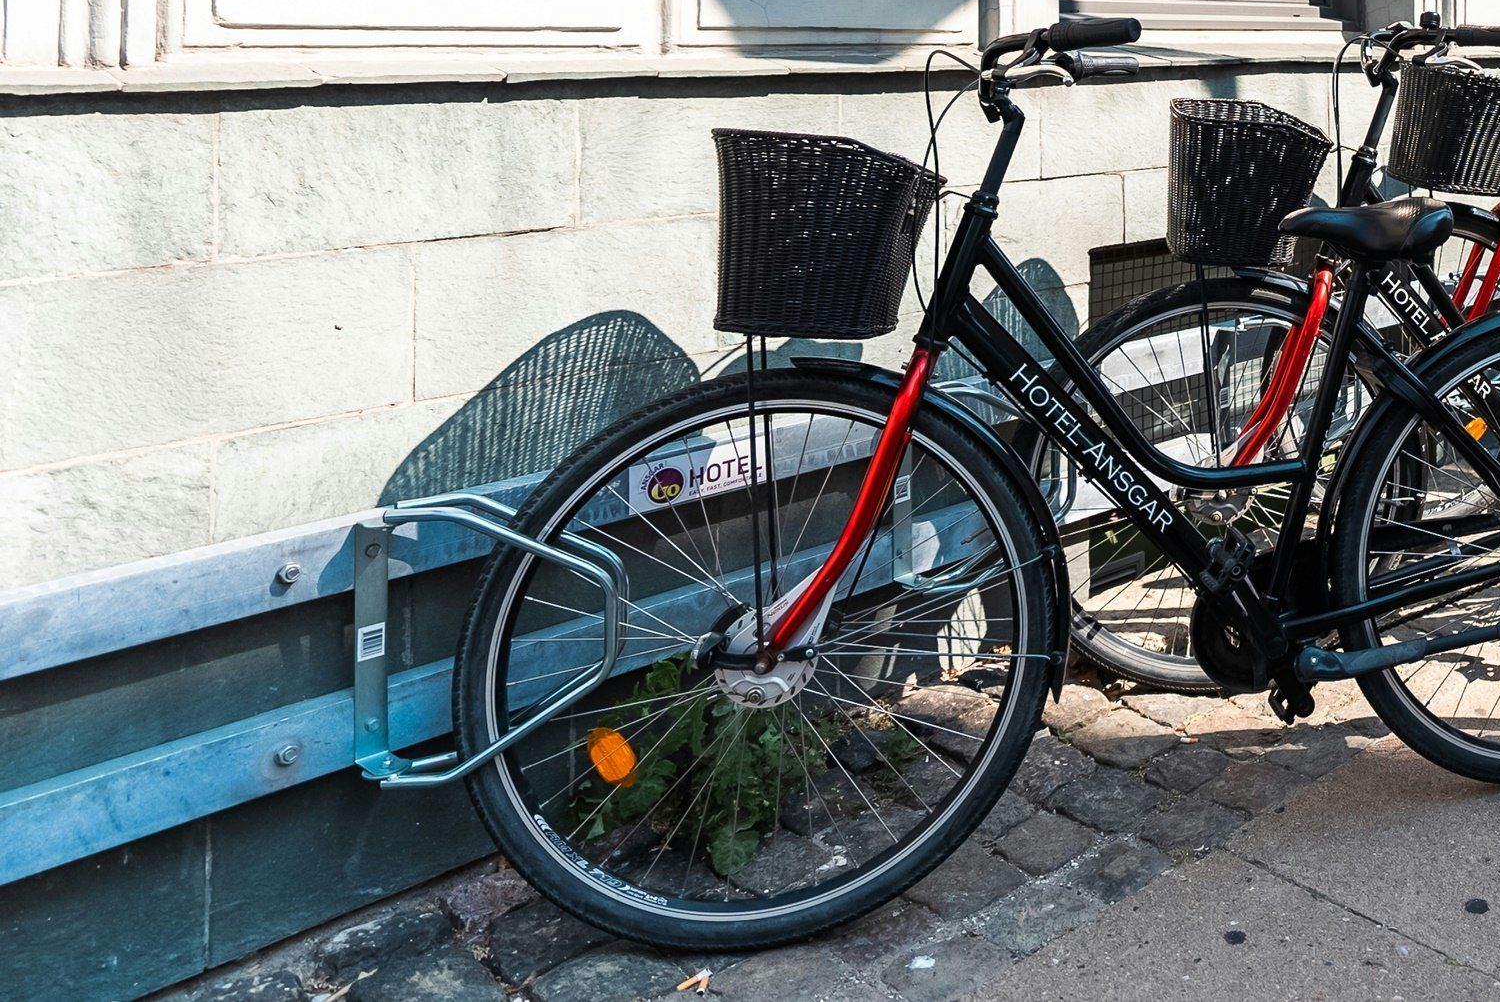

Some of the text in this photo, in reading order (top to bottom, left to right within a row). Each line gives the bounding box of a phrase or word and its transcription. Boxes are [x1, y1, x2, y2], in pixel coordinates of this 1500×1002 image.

[1381, 271, 1433, 335] HOTEL
[640, 462, 665, 491] ANSGAR
[1009, 363, 1174, 533] HOTEL ANSGAR
